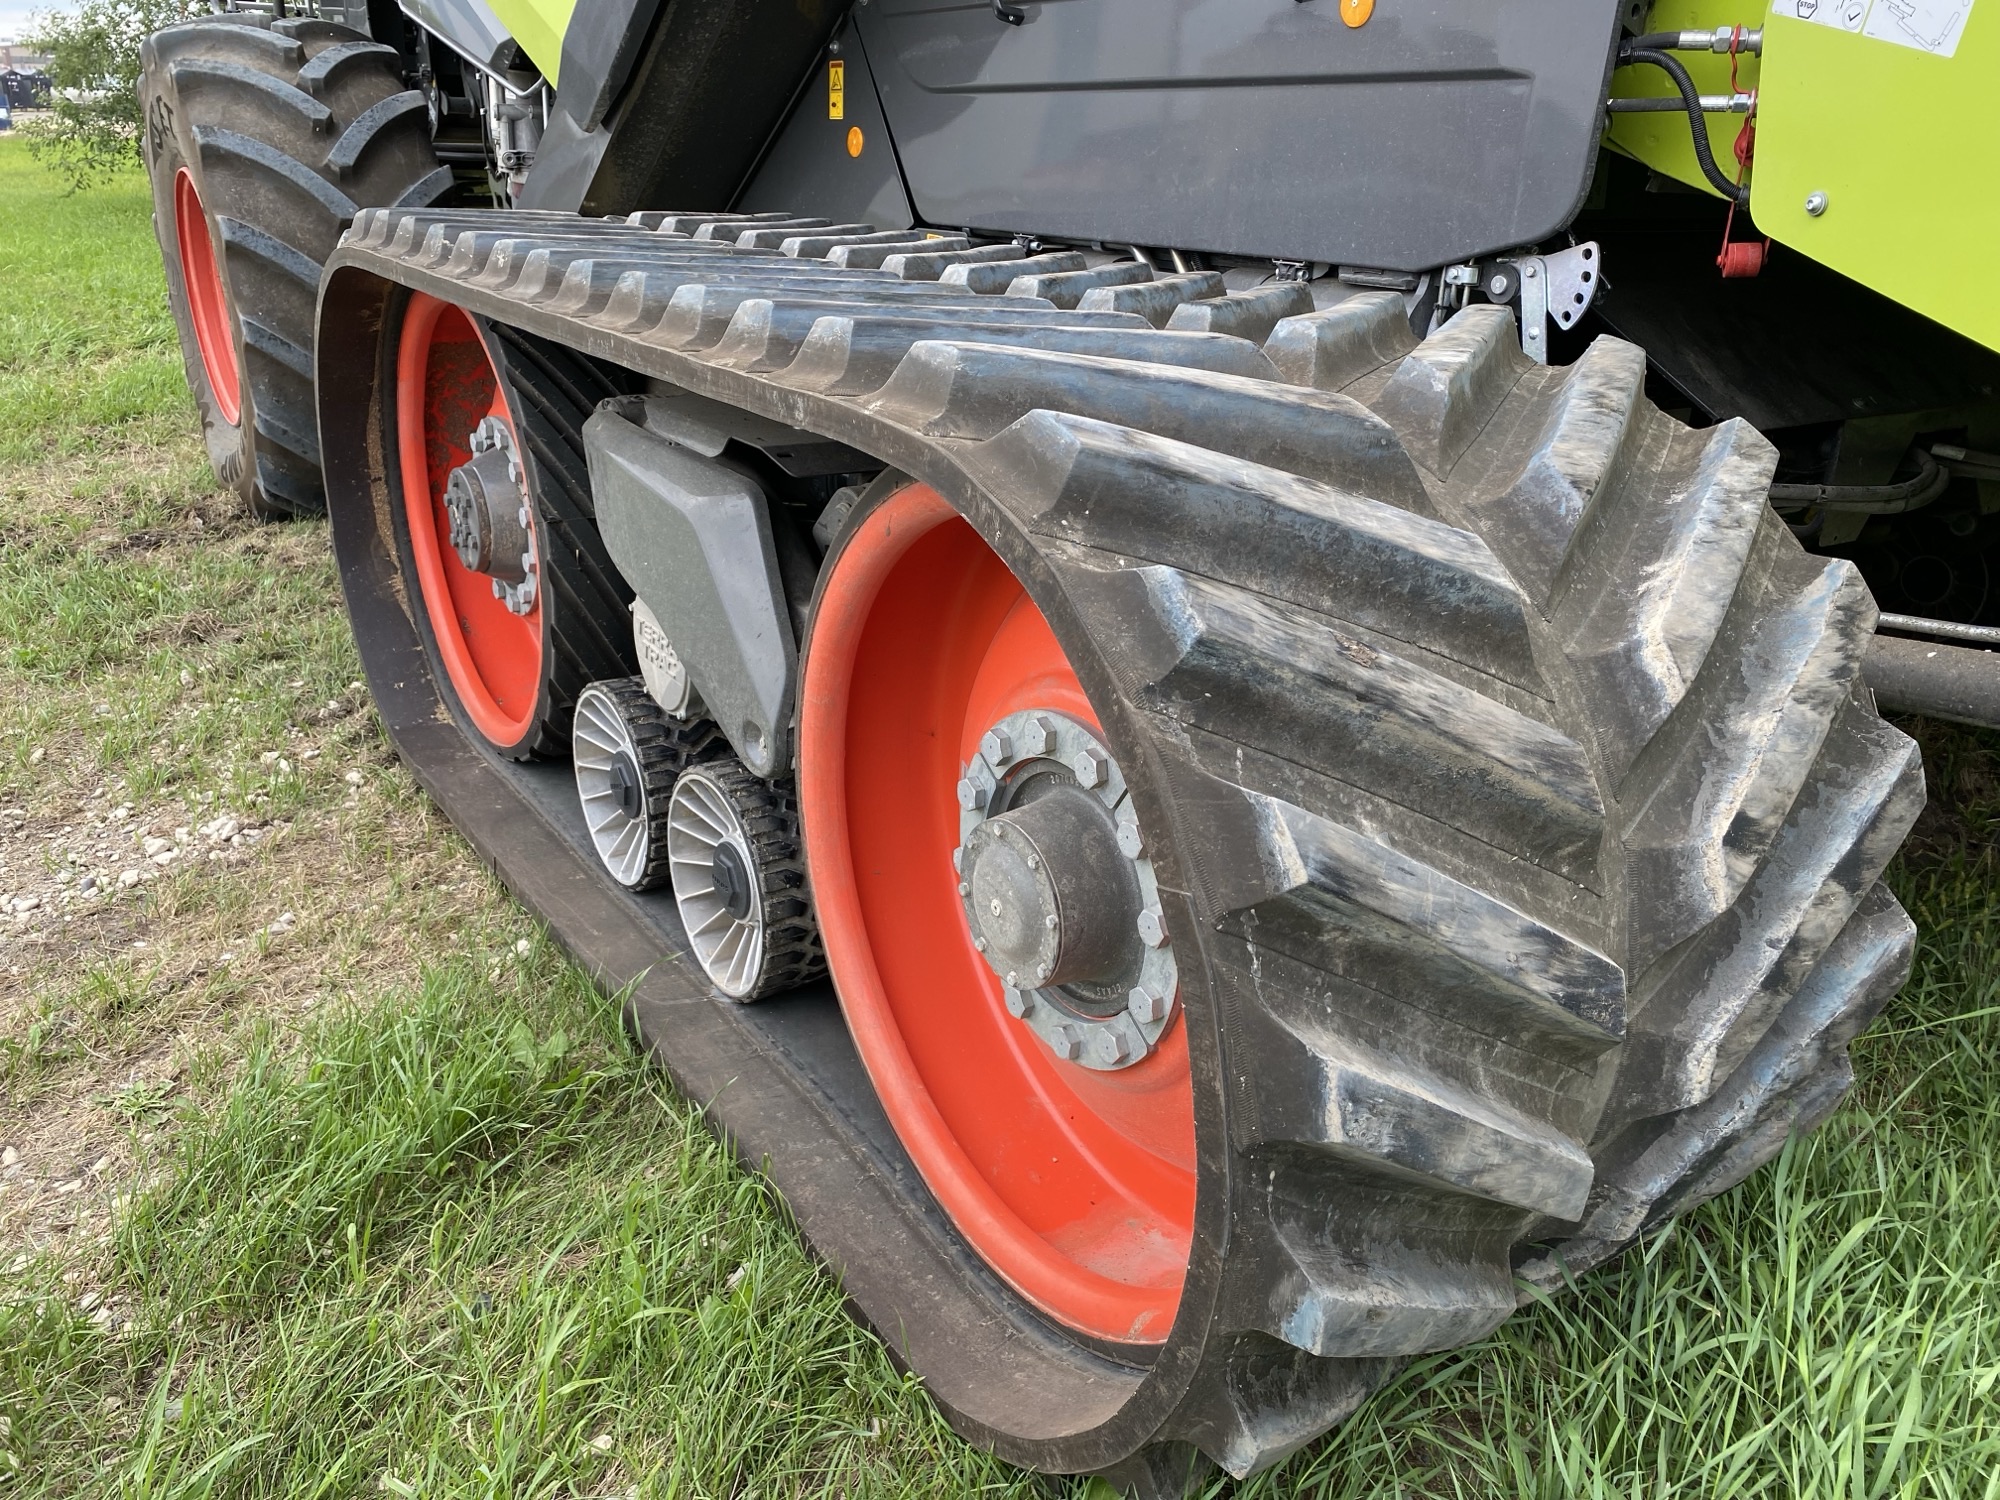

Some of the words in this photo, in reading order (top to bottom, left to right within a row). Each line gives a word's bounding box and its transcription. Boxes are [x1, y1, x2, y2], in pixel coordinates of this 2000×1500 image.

[1799, 1, 1816, 10] STOP
[642, 639, 679, 680] TRAC
[1096, 983, 1121, 996] CLAAS
